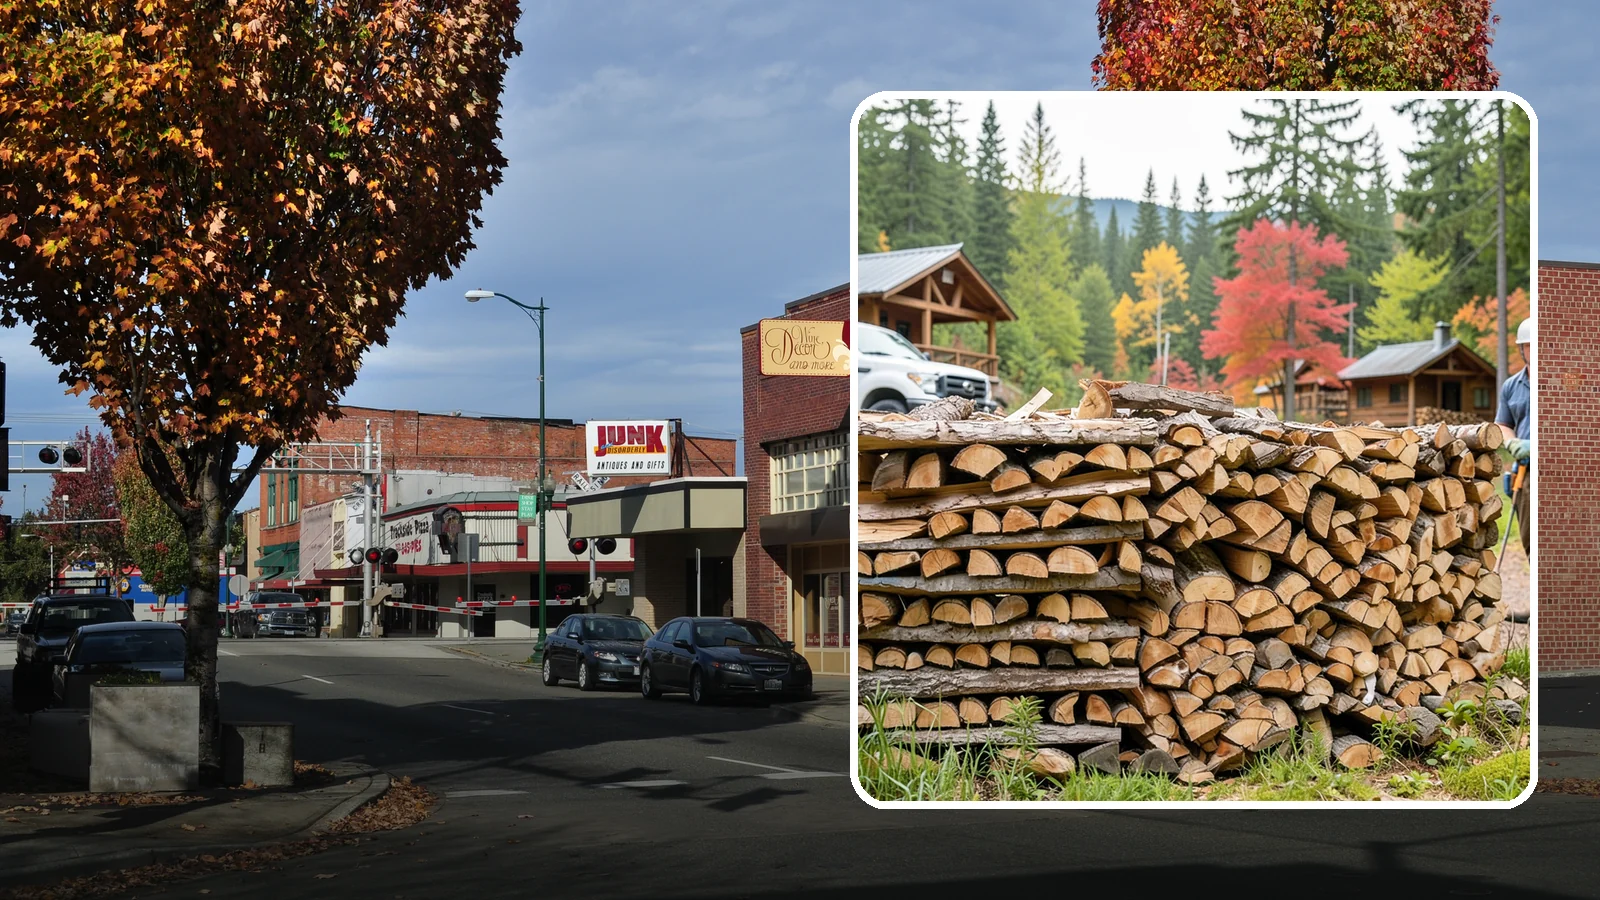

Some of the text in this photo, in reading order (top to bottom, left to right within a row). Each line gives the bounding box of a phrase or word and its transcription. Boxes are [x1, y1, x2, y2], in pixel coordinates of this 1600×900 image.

[595, 425, 664, 457] JUNK
[607, 446, 645, 454] DISORDERLY
[597, 460, 665, 470] ANTIQUES AND GIFTS
[590, 476, 608, 492] SING
[414, 519, 429, 535] Pizza
